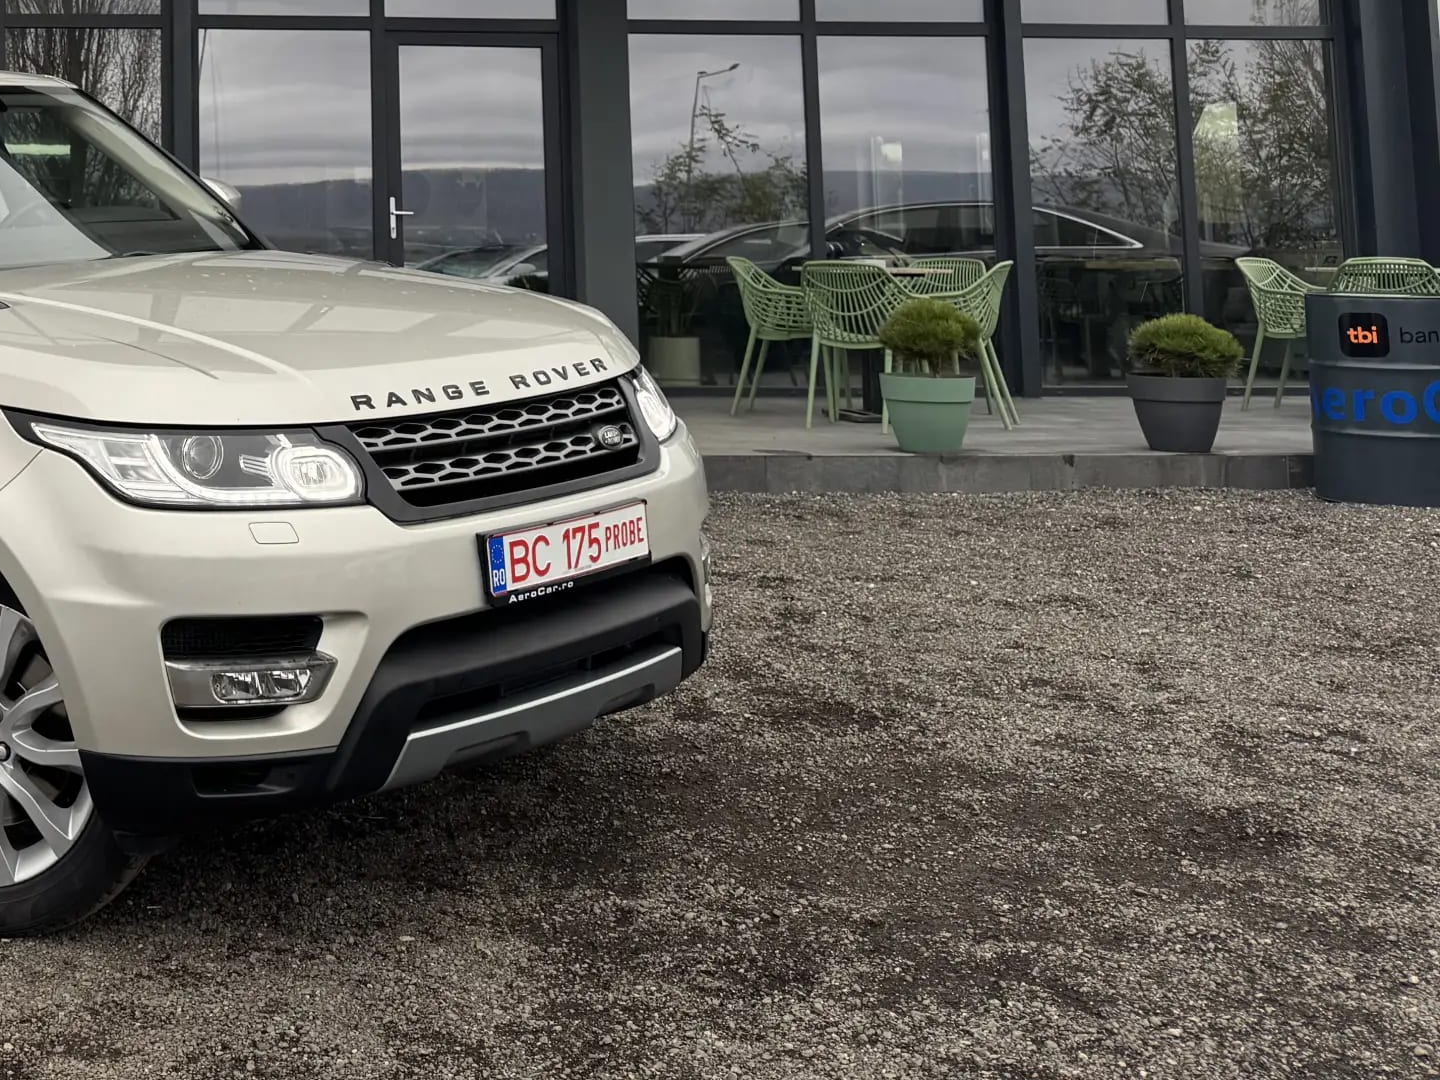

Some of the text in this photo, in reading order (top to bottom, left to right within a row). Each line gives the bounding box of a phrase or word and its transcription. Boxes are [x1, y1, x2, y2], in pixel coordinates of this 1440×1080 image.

[1346, 325, 1379, 344] tbi
[350, 357, 608, 411] RANGE ROVER
[508, 516, 645, 584] BC 175 PROBE
[492, 568, 506, 587] RO
[508, 580, 574, 604] AeroCar.ro
